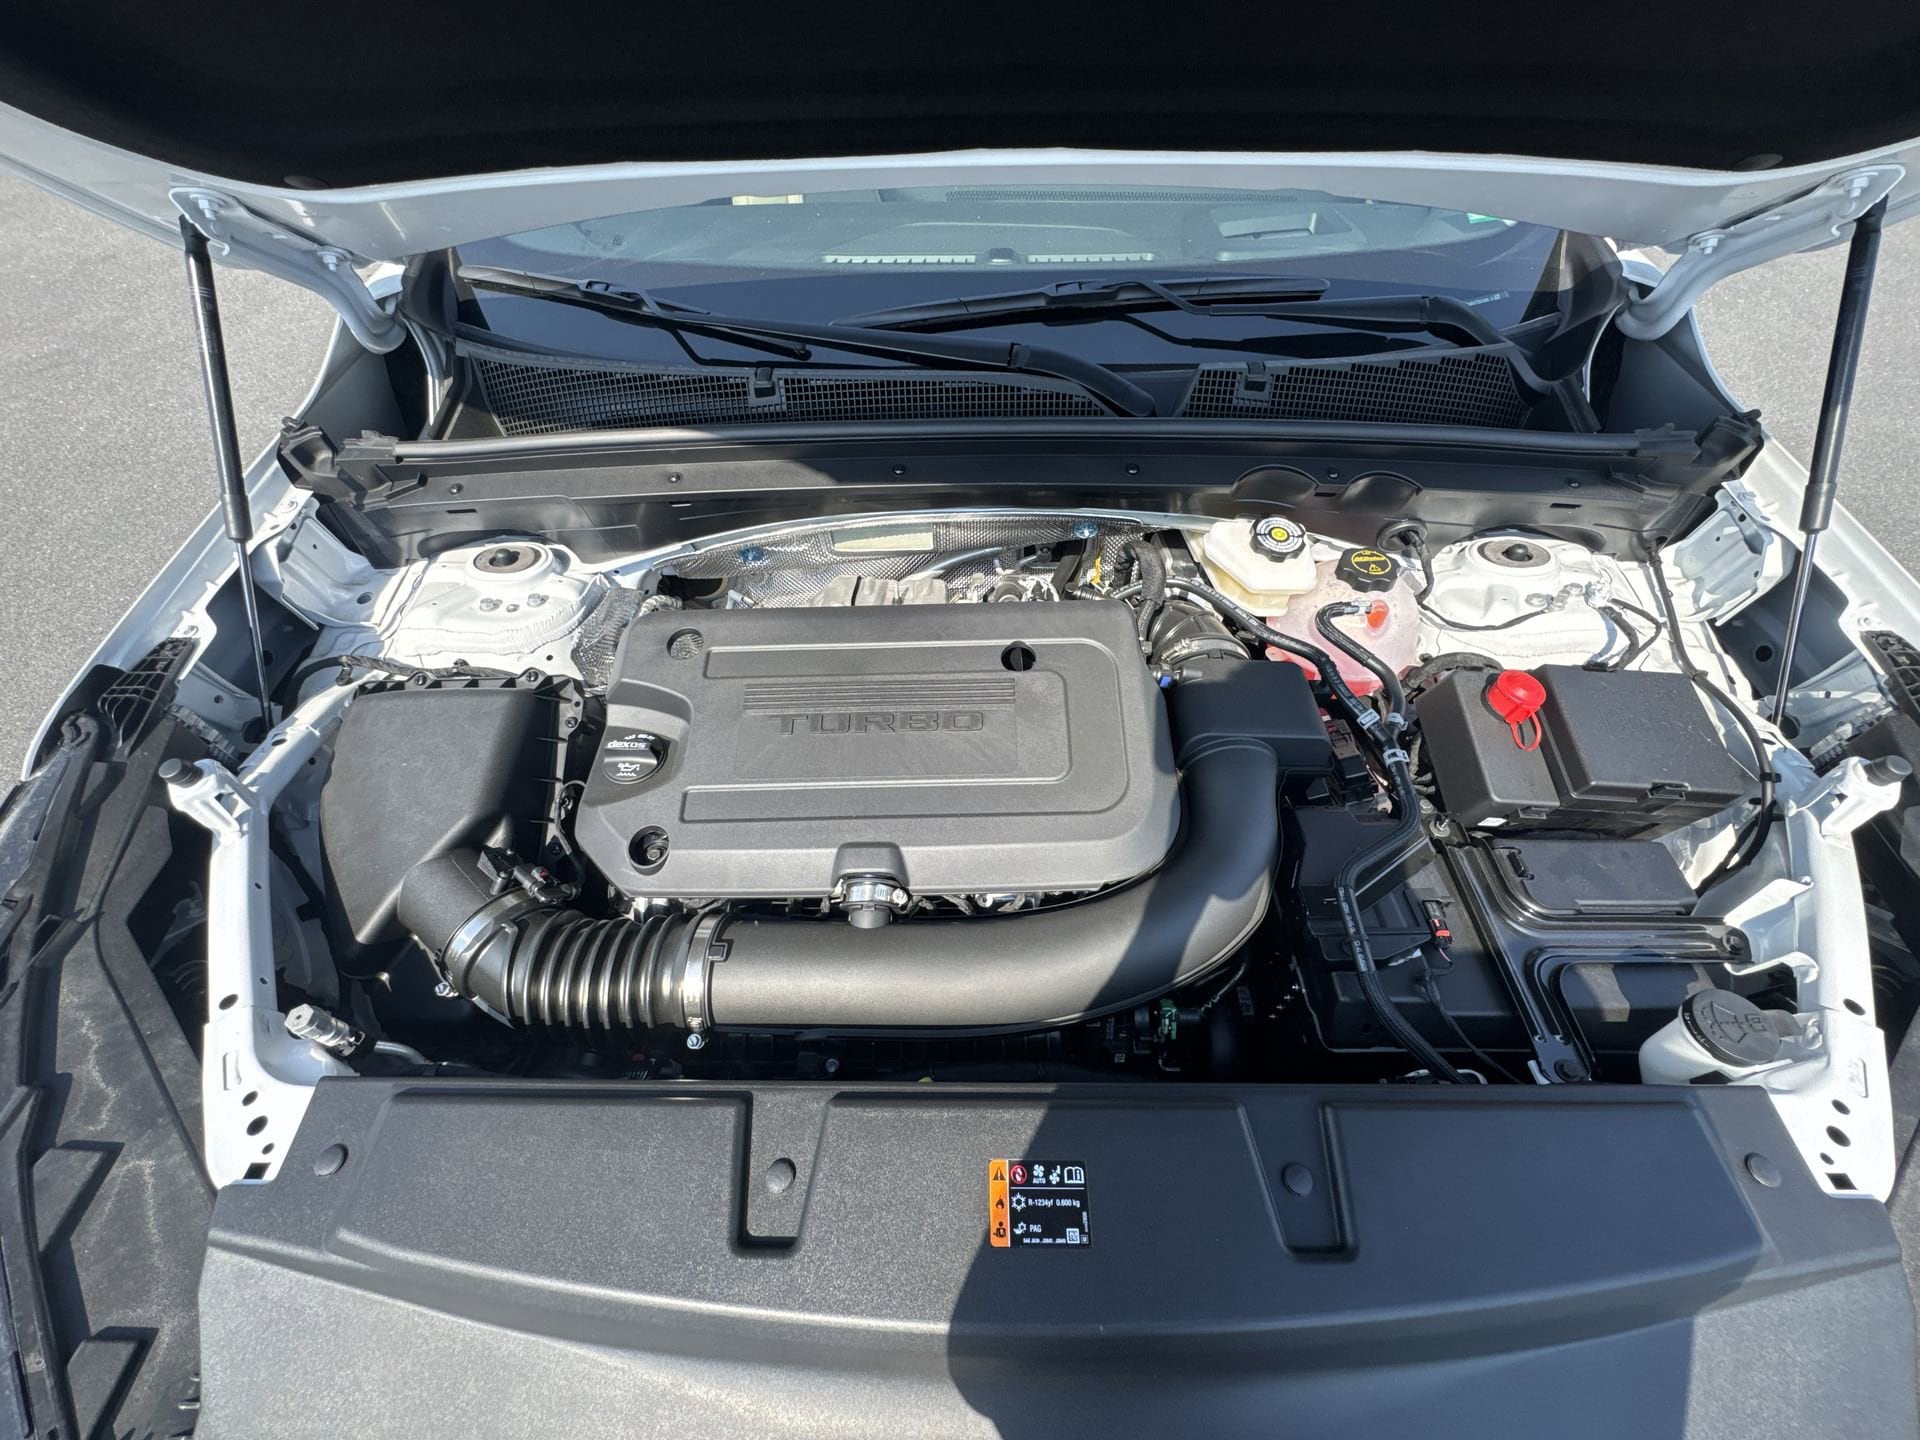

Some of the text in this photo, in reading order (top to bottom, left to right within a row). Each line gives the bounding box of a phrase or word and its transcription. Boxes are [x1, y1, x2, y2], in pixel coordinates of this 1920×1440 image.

[768, 711, 984, 735] TURBO
[607, 740, 647, 749] dexos
[1028, 1199, 1053, 1207] R-1234yf
[1073, 1199, 1080, 1208] kg
[1030, 1224, 1042, 1232] PAG
